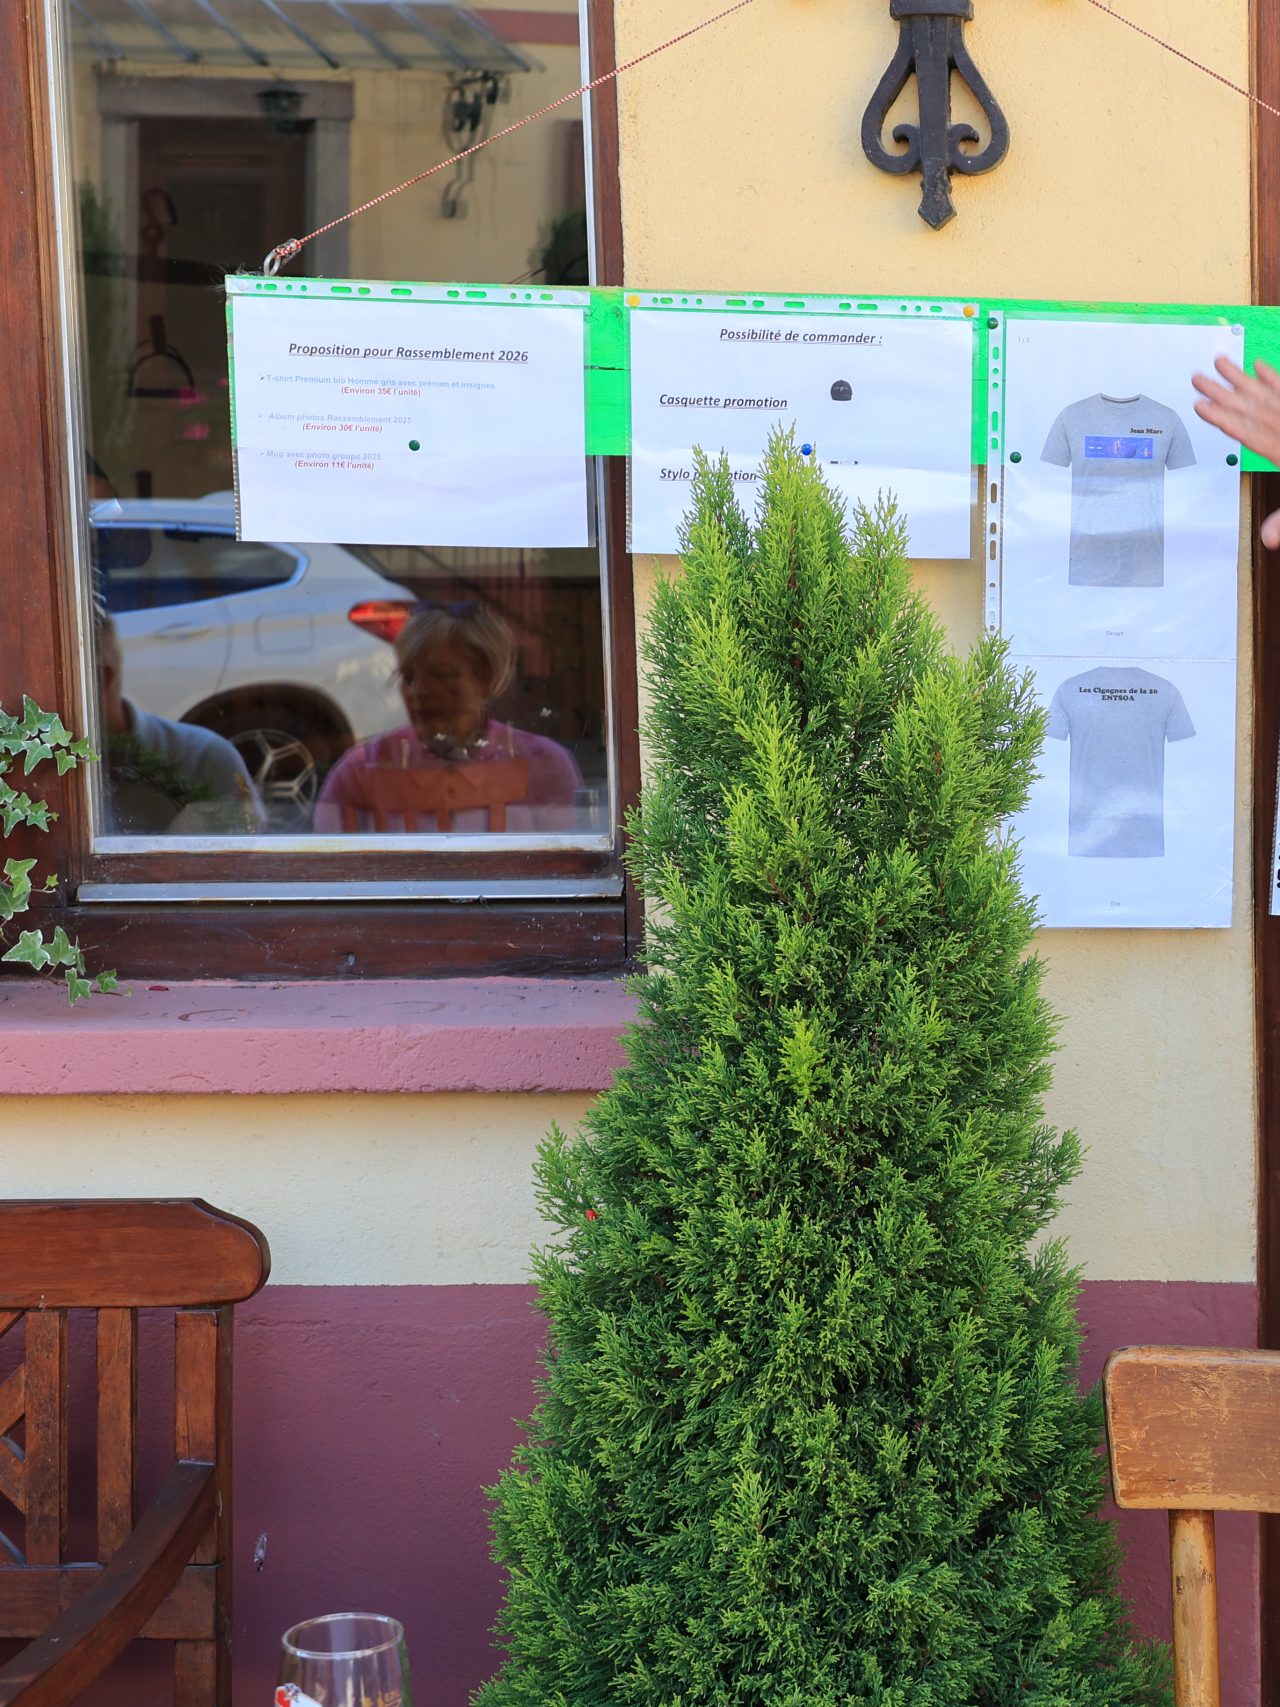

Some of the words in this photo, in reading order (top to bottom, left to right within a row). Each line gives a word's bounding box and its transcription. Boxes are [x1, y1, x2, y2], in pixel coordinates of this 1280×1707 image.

[720, 328, 781, 342] Possibilité
[784, 330, 799, 342] de
[802, 331, 876, 344] commander
[288, 343, 360, 357] Proposition
[363, 347, 393, 358] pour
[396, 346, 495, 361] Rassemblement
[498, 350, 529, 362] 2026
[266, 374, 293, 383] T-shirt
[295, 375, 331, 384] Premium
[333, 376, 346, 384] bio
[347, 377, 378, 386] Homme
[380, 378, 396, 388] gris
[451, 381, 460, 389] et
[461, 381, 495, 391] insignes
[341, 386, 376, 396] (Environ
[377, 387, 392, 396] 35€
[659, 394, 721, 409] Casquette
[723, 396, 788, 409] promotion
[268, 412, 295, 421] Album
[296, 413, 325, 423] photos
[327, 414, 391, 424] Rassemblement
[302, 423, 337, 433] (Environ
[339, 424, 353, 432] 30€
[266, 450, 284, 460] Mug
[306, 452, 331, 461] photo
[332, 453, 361, 462] groupe
[294, 459, 329, 470] (Environ
[331, 461, 346, 469] 11€
[659, 468, 690, 481] Stylo
[1093, 687, 1127, 695] Cigognes
[1101, 694, 1135, 702] ENTSOA
